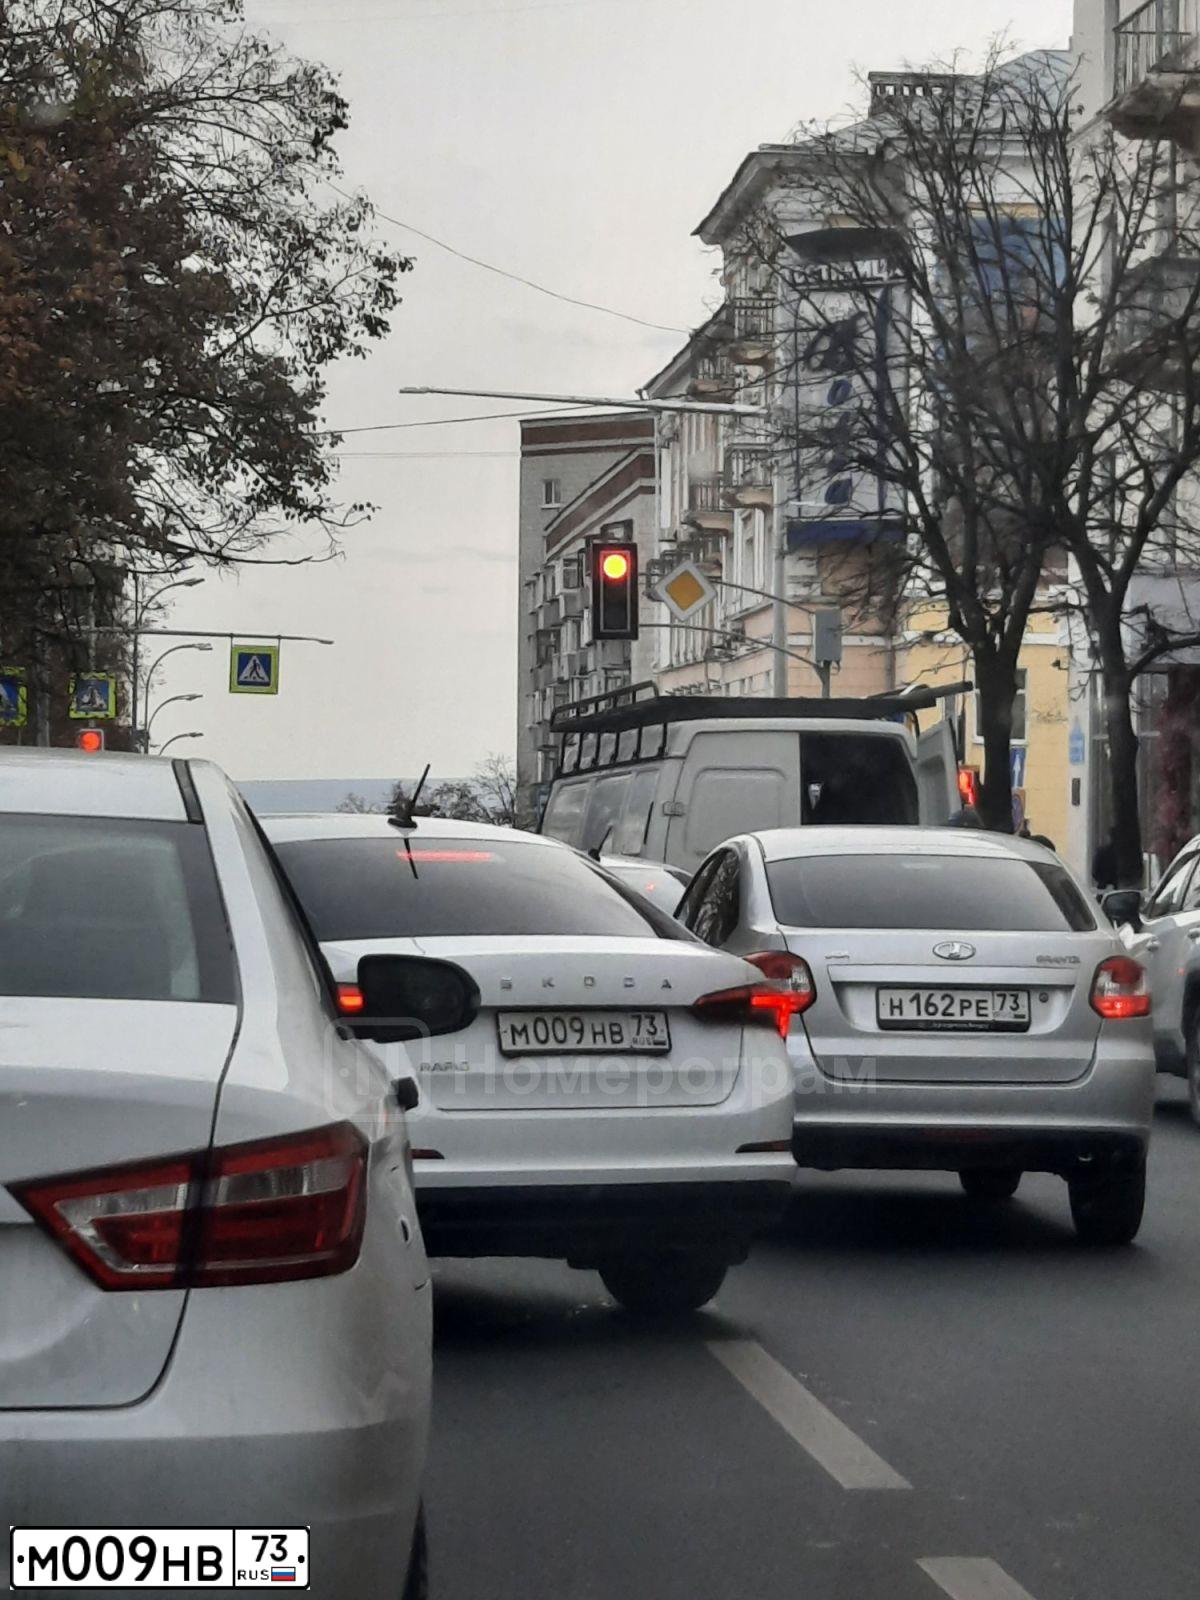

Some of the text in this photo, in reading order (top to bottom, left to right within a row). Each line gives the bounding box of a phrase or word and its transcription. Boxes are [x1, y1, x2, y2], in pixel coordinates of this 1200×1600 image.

[889, 992, 1020, 1018] Н162РЕ 73
[510, 1014, 658, 1046] М009НВ 73
